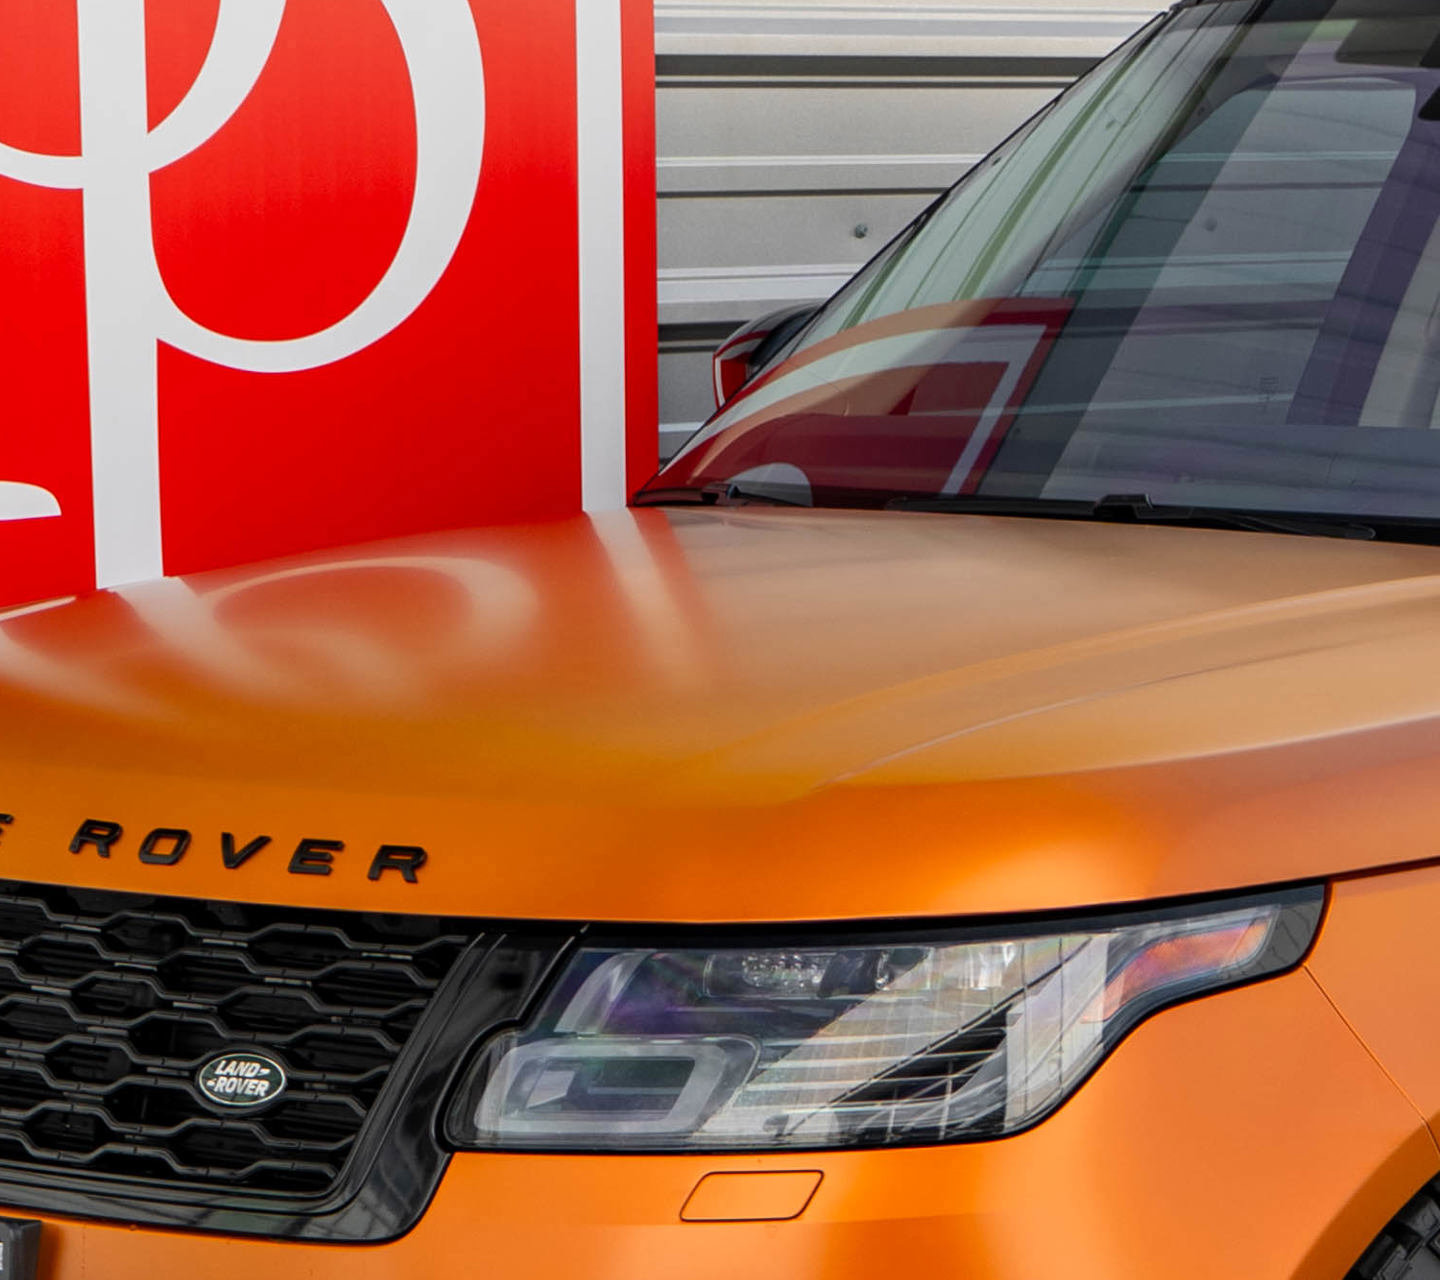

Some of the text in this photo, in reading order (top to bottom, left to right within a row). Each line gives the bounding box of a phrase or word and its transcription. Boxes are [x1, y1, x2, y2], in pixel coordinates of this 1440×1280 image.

[68, 818, 427, 884] ROVER
[214, 1060, 261, 1077] LAND
[213, 1076, 269, 1097] ROVER
